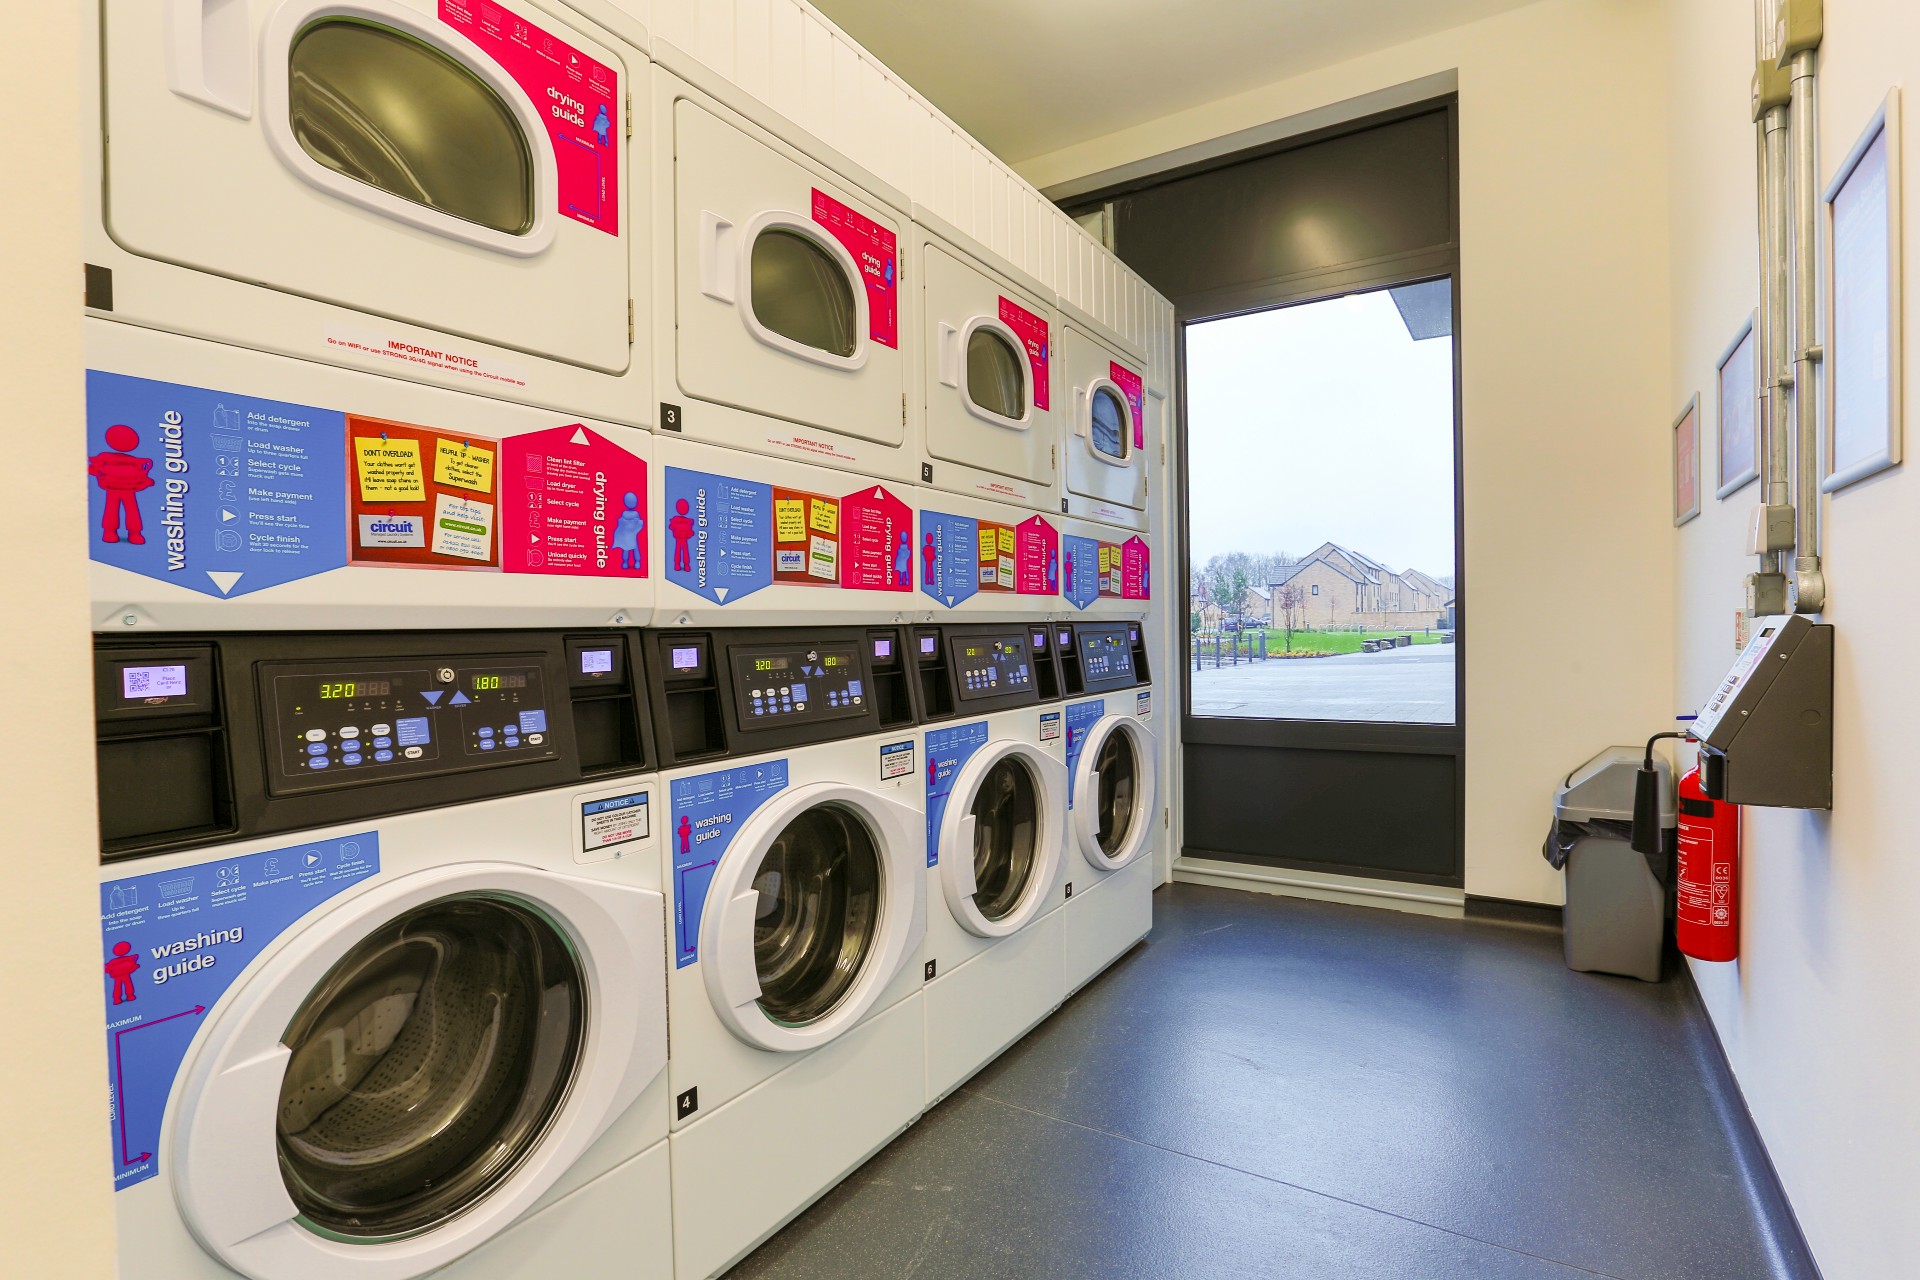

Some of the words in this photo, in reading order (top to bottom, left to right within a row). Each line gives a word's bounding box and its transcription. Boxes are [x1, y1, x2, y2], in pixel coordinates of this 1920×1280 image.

[547, 86, 585, 114] drying
[552, 104, 585, 128] guide
[862, 252, 881, 268] drying
[864, 264, 881, 278] guide
[382, 350, 408, 360] STRONG
[428, 360, 443, 368] signal
[388, 340, 443, 360] IMPORTANT
[446, 354, 478, 368] NOTICE
[247, 412, 265, 420] Add
[268, 416, 310, 427] detergent
[667, 410, 675, 423] 3
[159, 410, 189, 474] guide
[248, 440, 270, 449] Load
[273, 444, 304, 454] washer
[793, 437, 818, 448] IMPORTANT
[818, 442, 833, 450] NOTICE
[248, 459, 276, 468] Select
[279, 464, 301, 472] cycle
[924, 467, 928, 476] 5
[449, 473, 478, 485] Superwash
[248, 488, 273, 496] Make
[276, 490, 313, 500] payment
[594, 472, 607, 521] drying
[696, 489, 708, 526] guide
[249, 512, 274, 520] Press
[160, 478, 189, 571] washing
[370, 520, 413, 532] circuit
[250, 534, 274, 542] Cycle
[277, 535, 300, 543] finish
[594, 525, 608, 568] guide
[696, 530, 708, 587] washing
[782, 554, 800, 562] circuit
[476, 676, 498, 689] 1.80
[321, 684, 354, 698] 3.20
[938, 757, 957, 768] washing
[938, 768, 952, 780] guide
[604, 799, 628, 809] NOTICE
[696, 813, 732, 828] washing
[696, 828, 720, 844] guide
[270, 875, 293, 885] payment
[176, 895, 199, 904] washer
[101, 912, 115, 921] Add
[117, 906, 149, 917] detergent
[151, 926, 243, 959] washing
[153, 953, 216, 984] guide
[928, 965, 932, 974] 6
[683, 1096, 690, 1108] 4
[115, 1164, 149, 1181] MINIMUM
